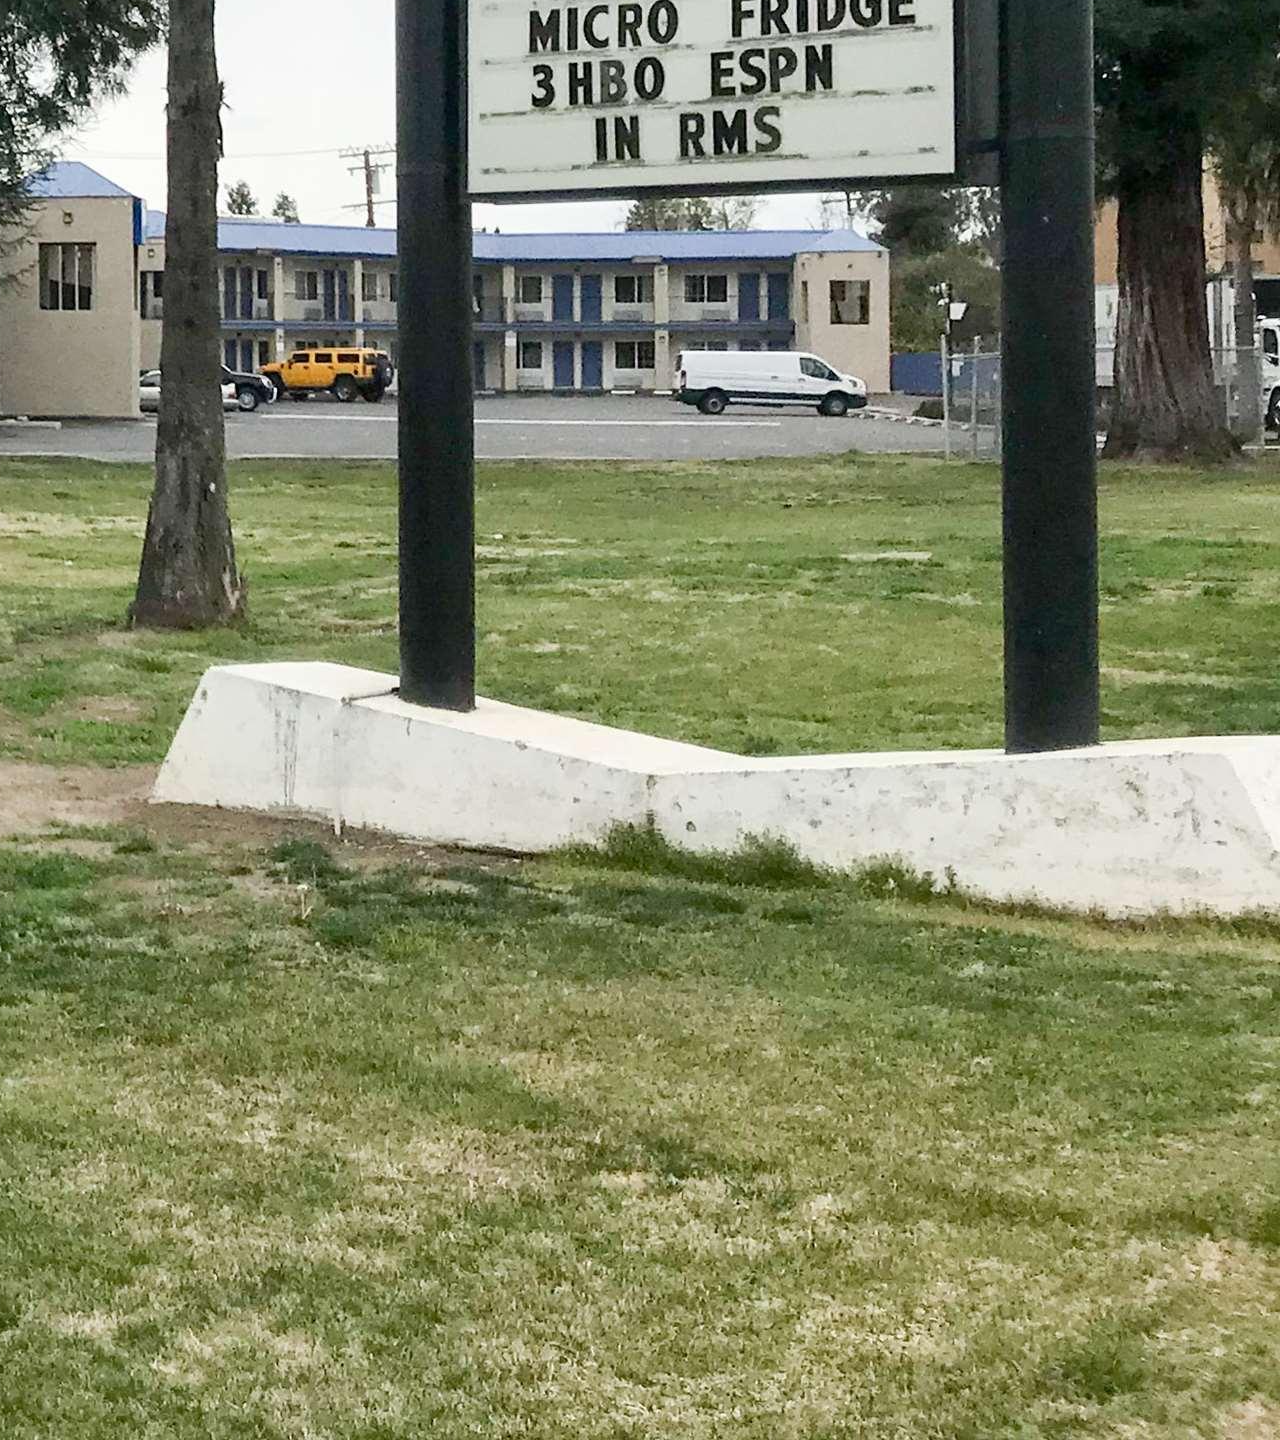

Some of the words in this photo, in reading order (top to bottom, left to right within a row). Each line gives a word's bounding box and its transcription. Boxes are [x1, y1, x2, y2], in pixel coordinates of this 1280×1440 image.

[529, 0, 679, 53] MICRO
[710, 44, 833, 98] ESPN
[595, 115, 640, 161] IN
[679, 106, 782, 157] RMS
